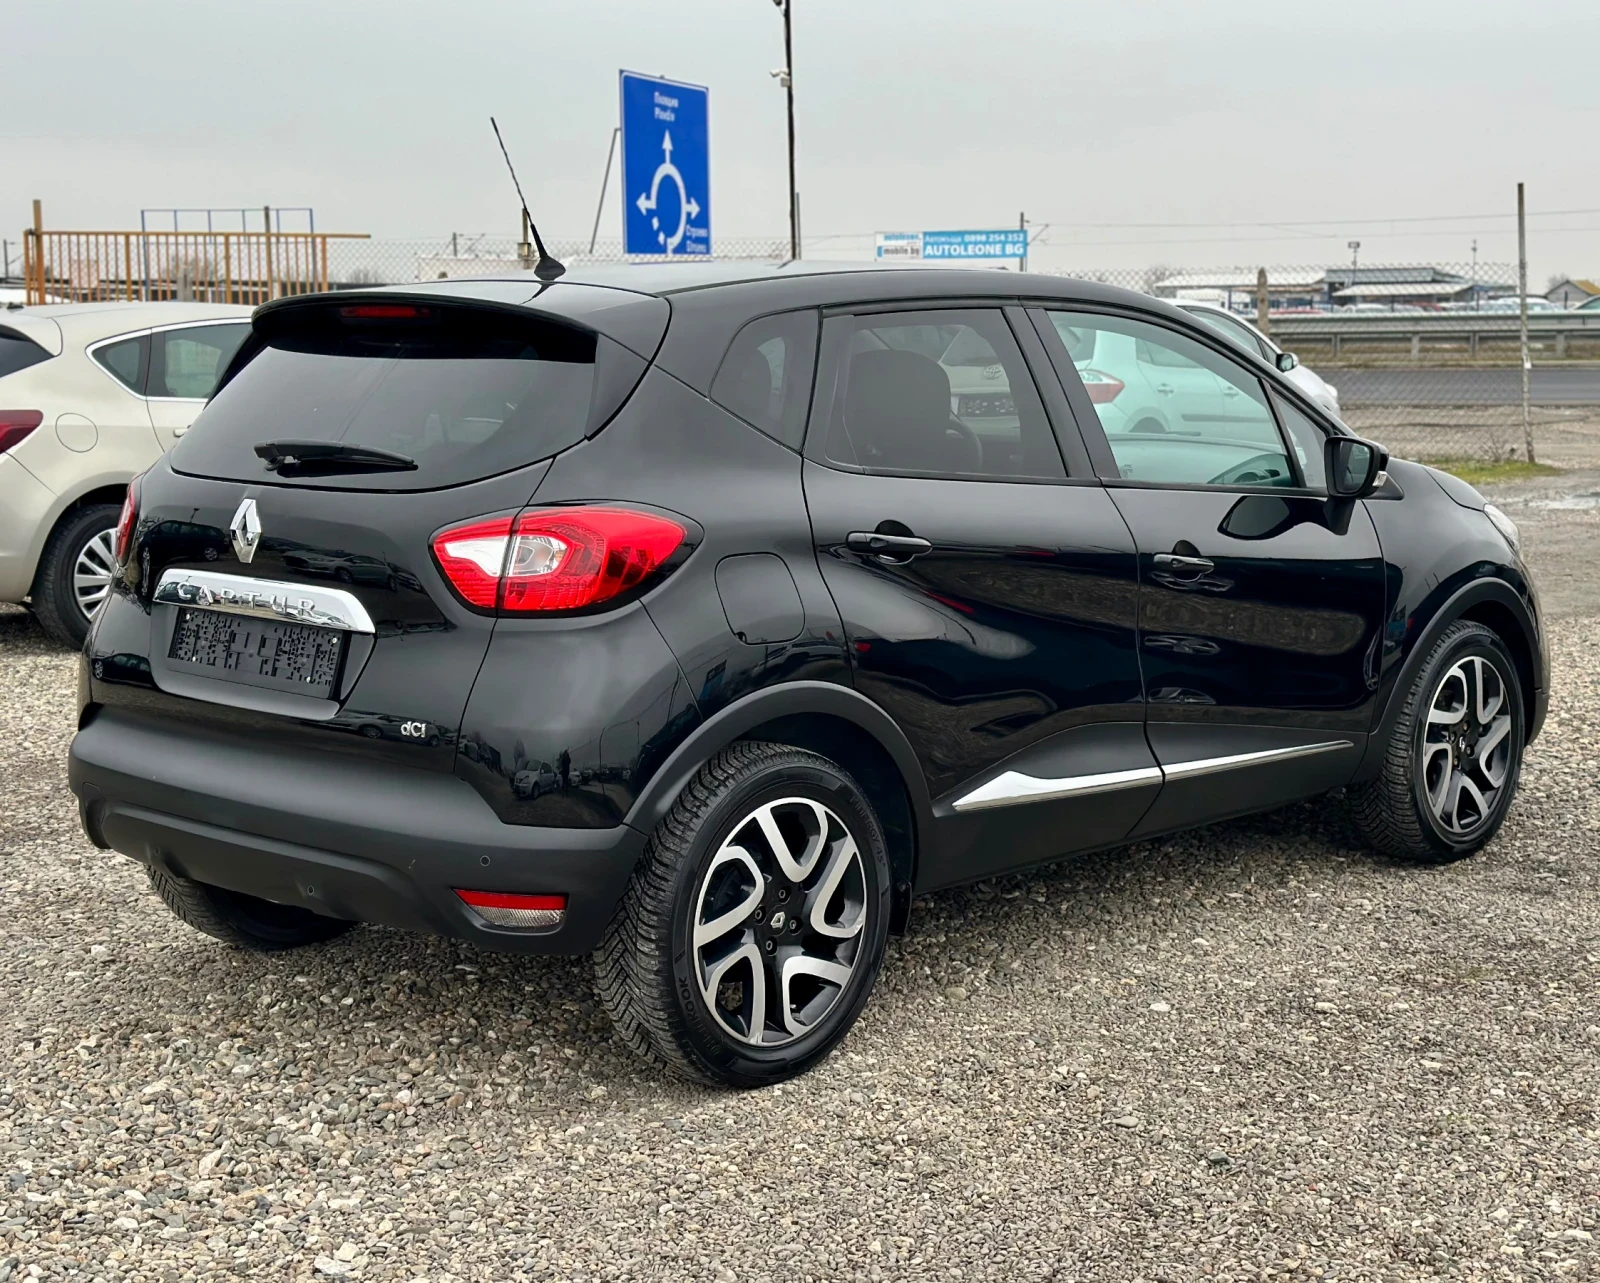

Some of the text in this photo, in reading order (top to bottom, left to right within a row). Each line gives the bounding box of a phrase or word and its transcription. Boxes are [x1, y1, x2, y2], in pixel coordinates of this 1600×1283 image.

[924, 242, 1024, 256] AUTOLEONE BG
[177, 581, 315, 617] CAPTUR
